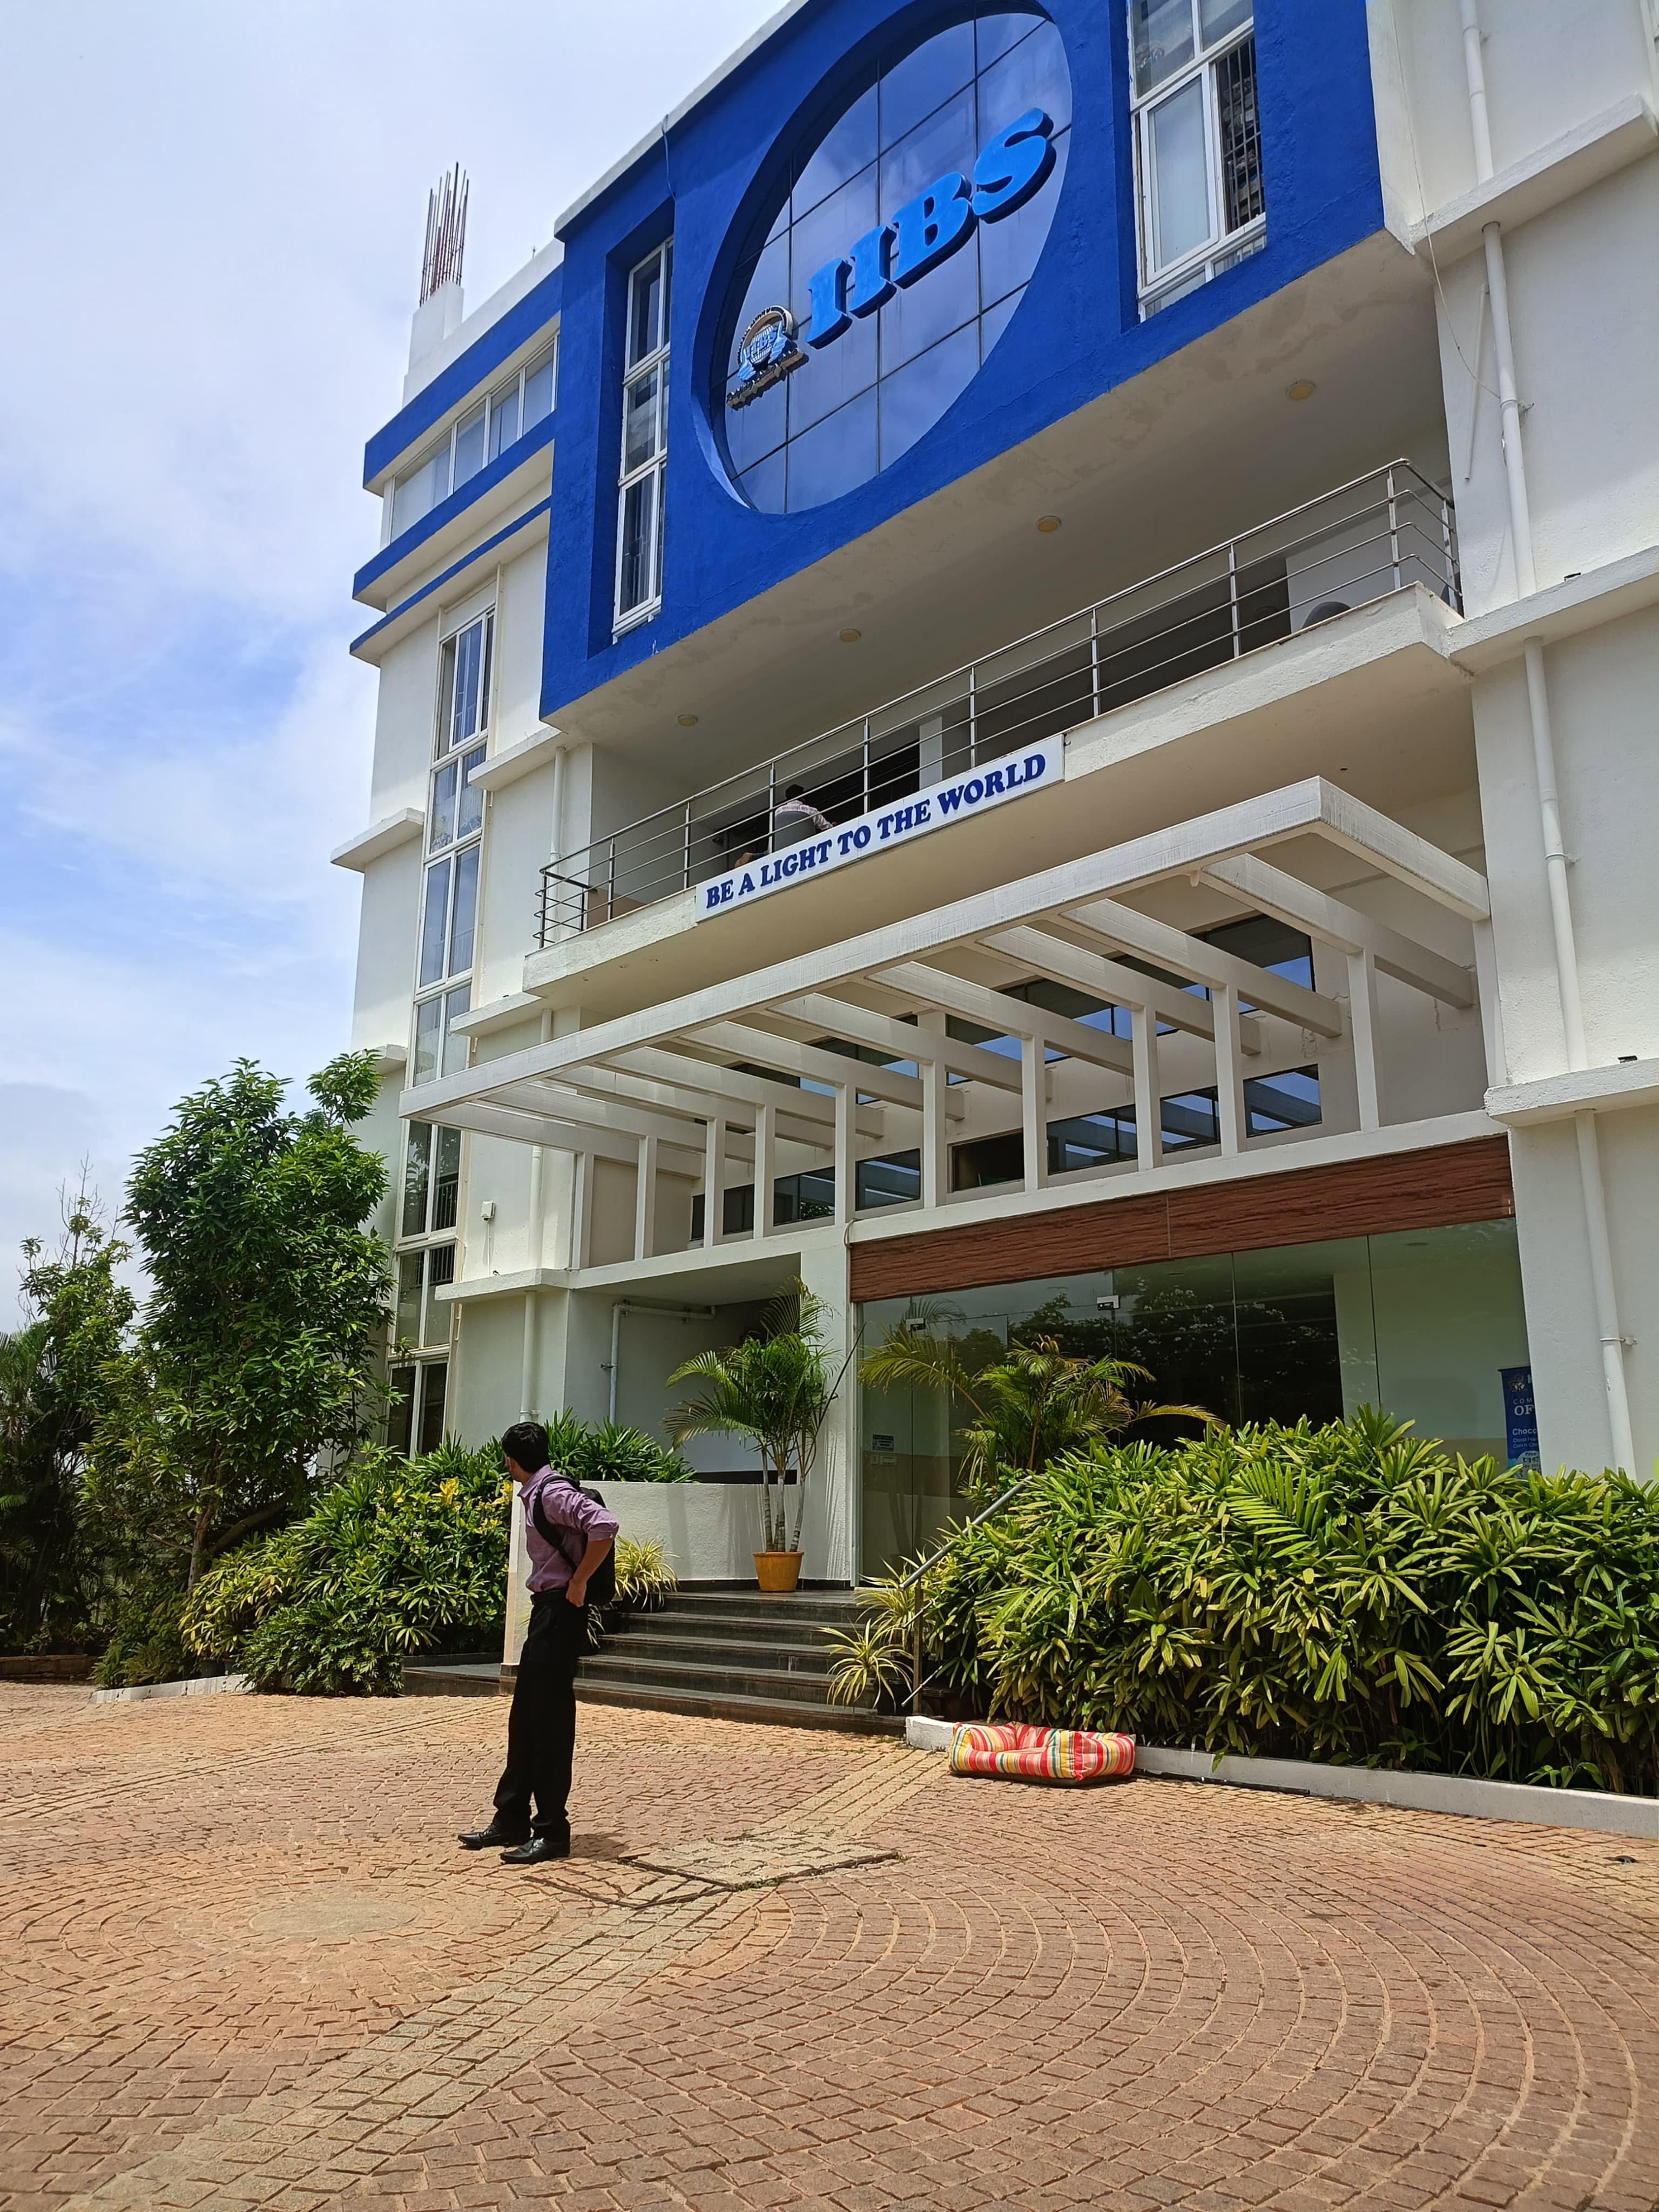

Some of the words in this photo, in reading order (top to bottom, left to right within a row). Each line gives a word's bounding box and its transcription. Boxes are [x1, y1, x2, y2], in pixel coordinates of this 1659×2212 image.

[805, 107, 1056, 349] IIBS
[706, 879, 734, 909] BE
[738, 873, 755, 896] A
[760, 839, 832, 887] LIGHT
[838, 825, 871, 855] TO
[877, 799, 931, 840] THE
[937, 754, 1046, 814] WORLD
